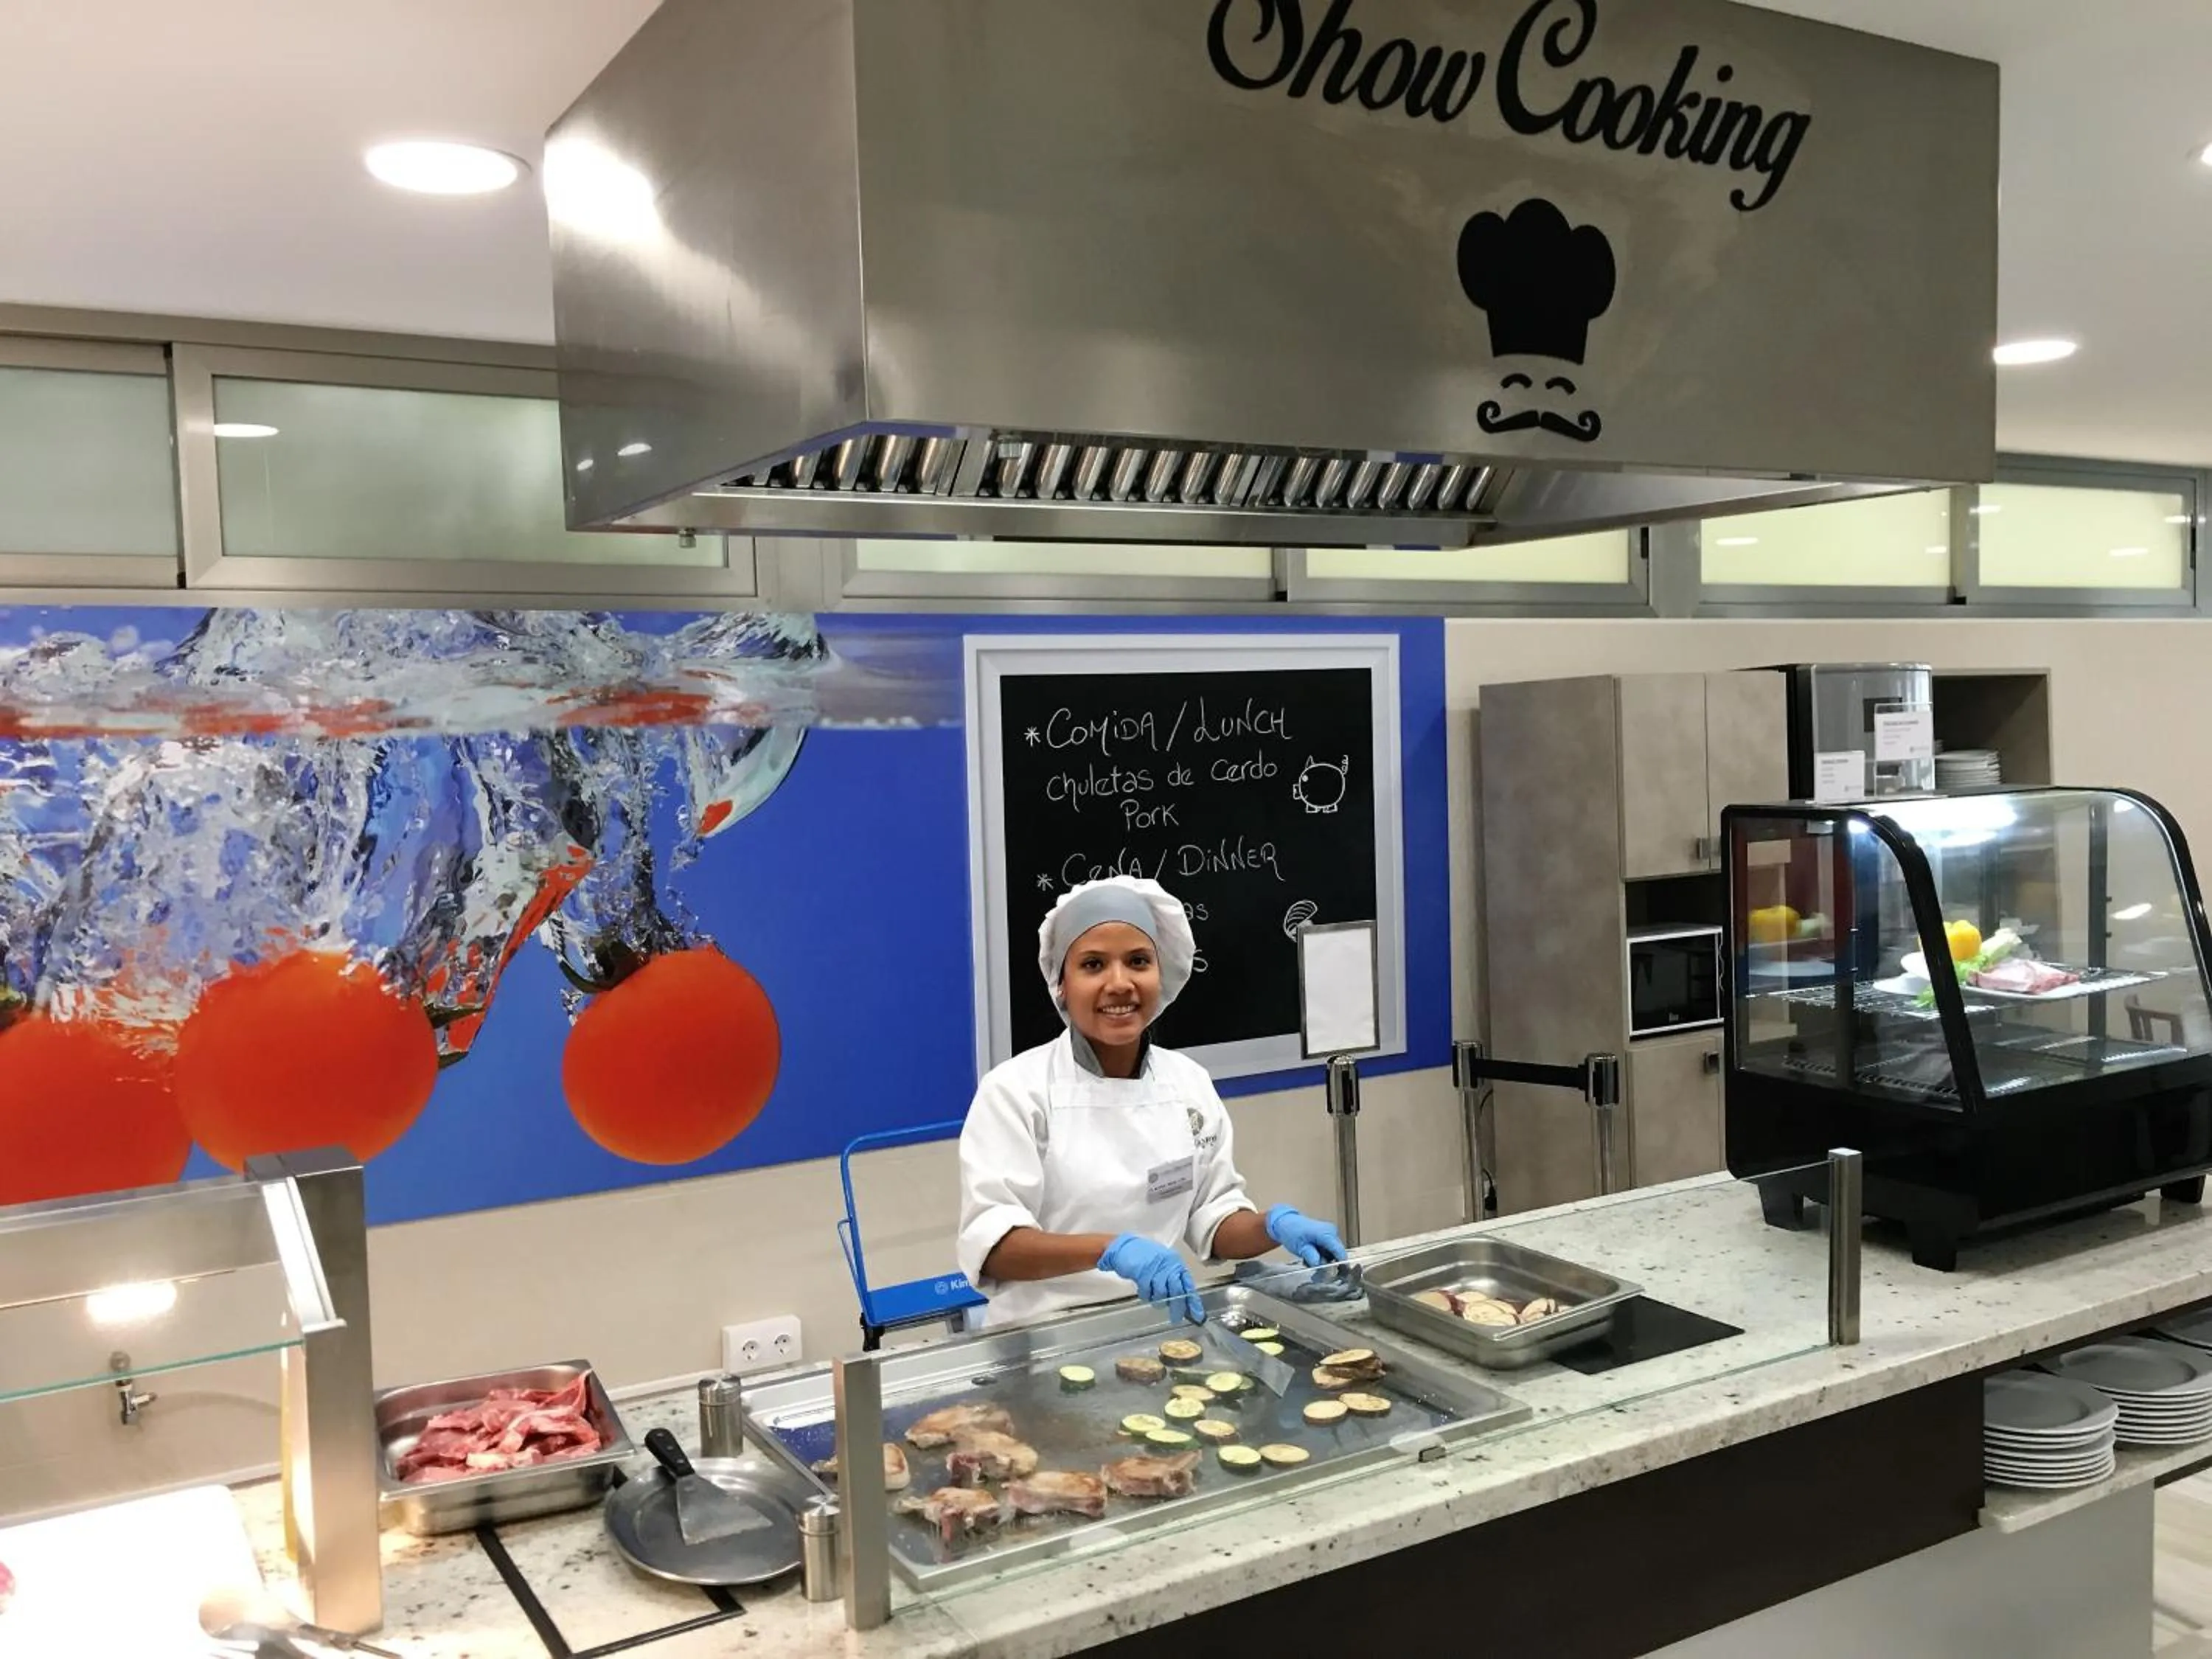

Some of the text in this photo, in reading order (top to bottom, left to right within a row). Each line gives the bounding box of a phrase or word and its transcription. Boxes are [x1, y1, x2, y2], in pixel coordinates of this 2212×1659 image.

[1207, 0, 1812, 212] Show Cooking
[1167, 762, 1194, 787] de
